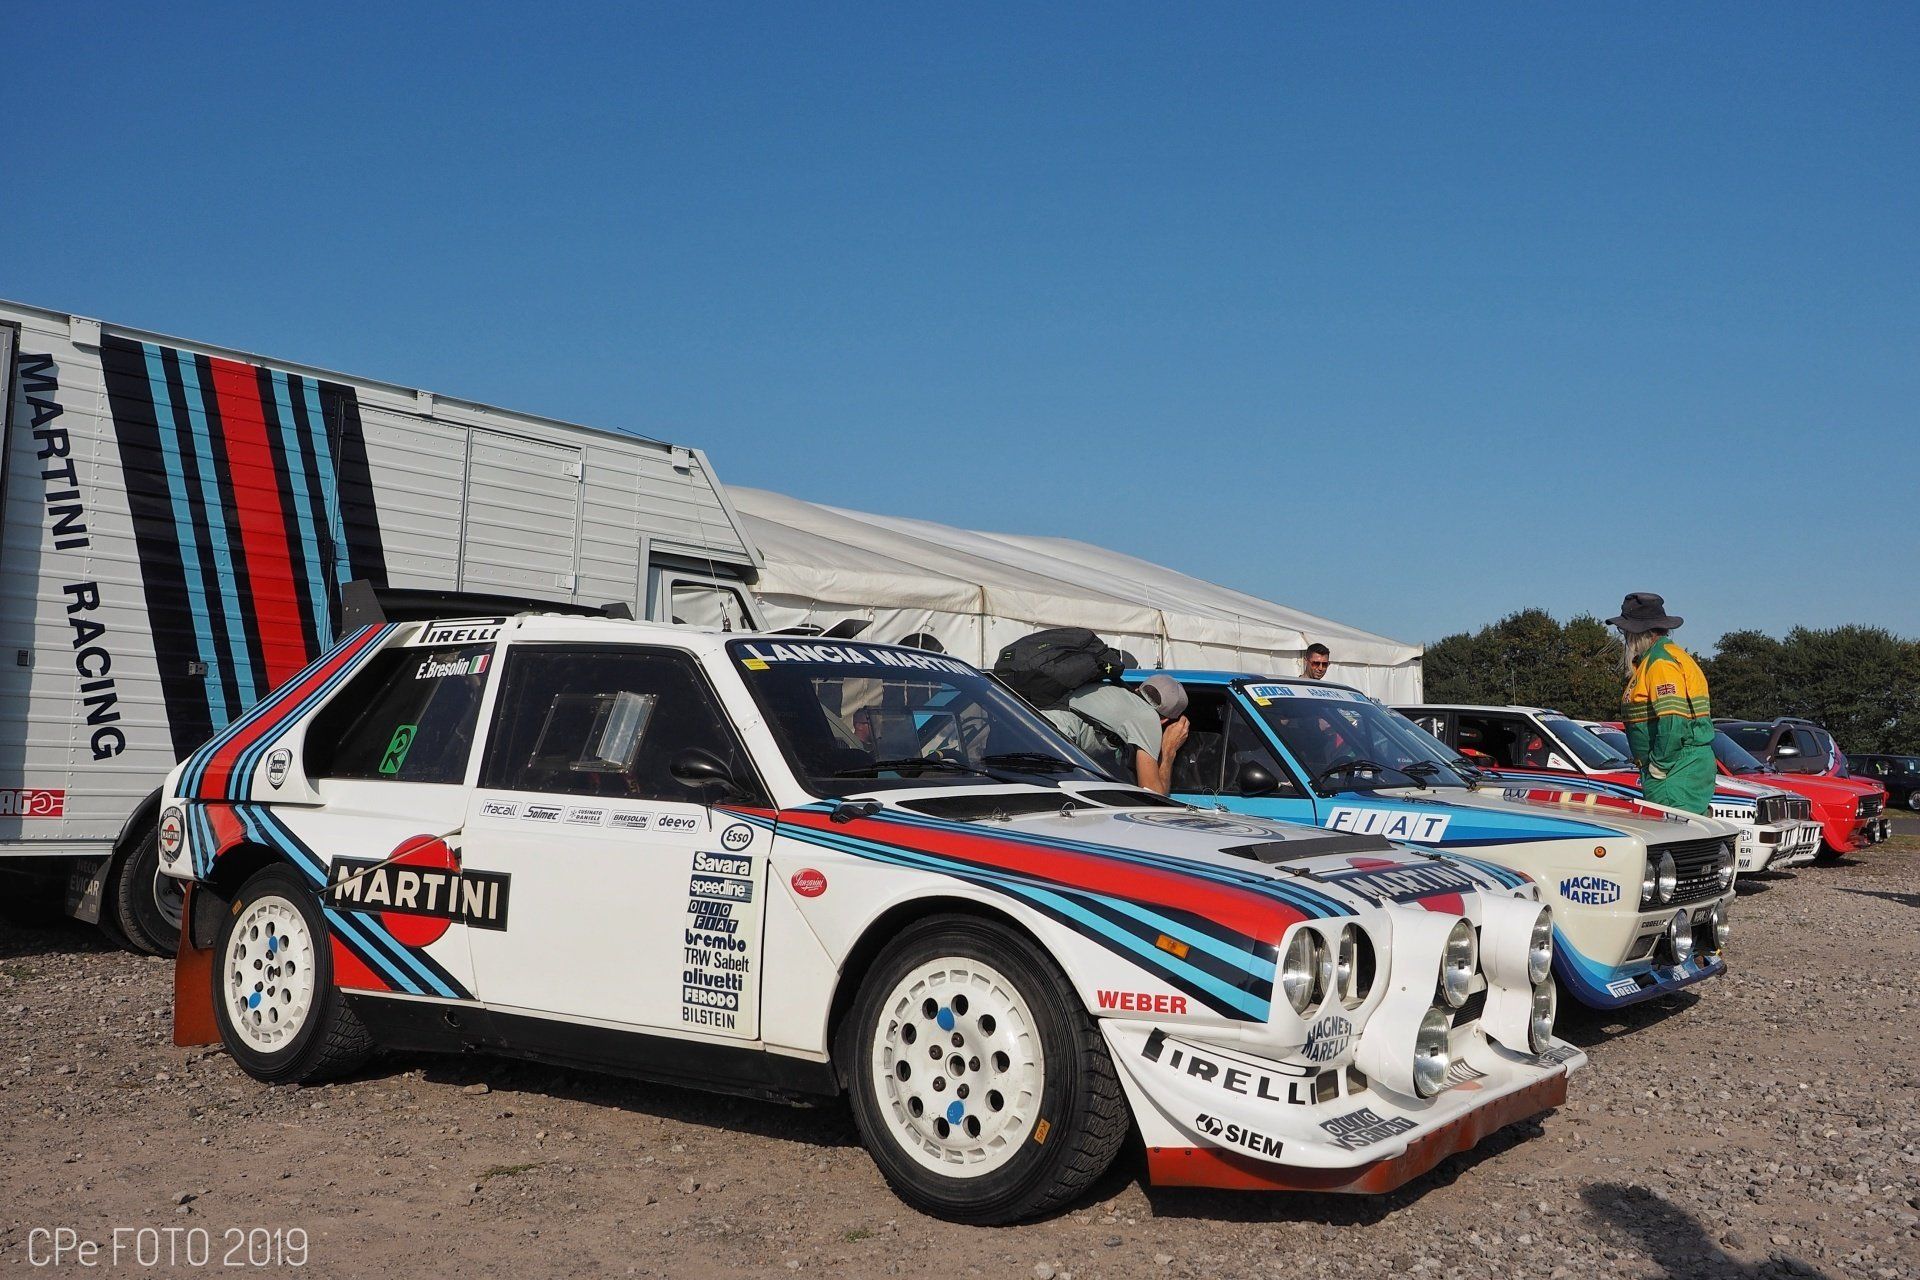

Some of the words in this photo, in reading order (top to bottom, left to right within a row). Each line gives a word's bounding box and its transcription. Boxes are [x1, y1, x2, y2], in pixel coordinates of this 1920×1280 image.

[20, 353, 89, 550] MARTINI
[63, 581, 126, 761] RACING
[419, 618, 506, 643] PIRELLI
[744, 644, 875, 665] LANCIA
[869, 649, 979, 678] MARTINI
[1253, 686, 1293, 696] FIAT
[523, 806, 562, 820] Solmec
[613, 814, 648, 823] BRESOLIN
[658, 815, 696, 829] deevo
[1332, 811, 1443, 838] FIAT
[694, 852, 750, 875] Savara
[334, 865, 499, 920] MARTINI
[690, 879, 746, 898] speedline
[1340, 865, 1469, 900] MARTINI
[1560, 876, 1620, 895] MAGNETI
[690, 901, 730, 916] OLIO
[696, 917, 737, 932] FIAT
[685, 928, 747, 953] brembo
[684, 947, 711, 967] TRW
[714, 951, 749, 973] Sabelt
[683, 968, 743, 992] olivetti
[684, 987, 737, 1009] FERODO
[1097, 990, 1187, 1014] WEBER
[683, 1006, 735, 1030] BILSTEIN
[1141, 1027, 1321, 1105] PIRELLI
[1225, 1123, 1284, 1159] SIEM
